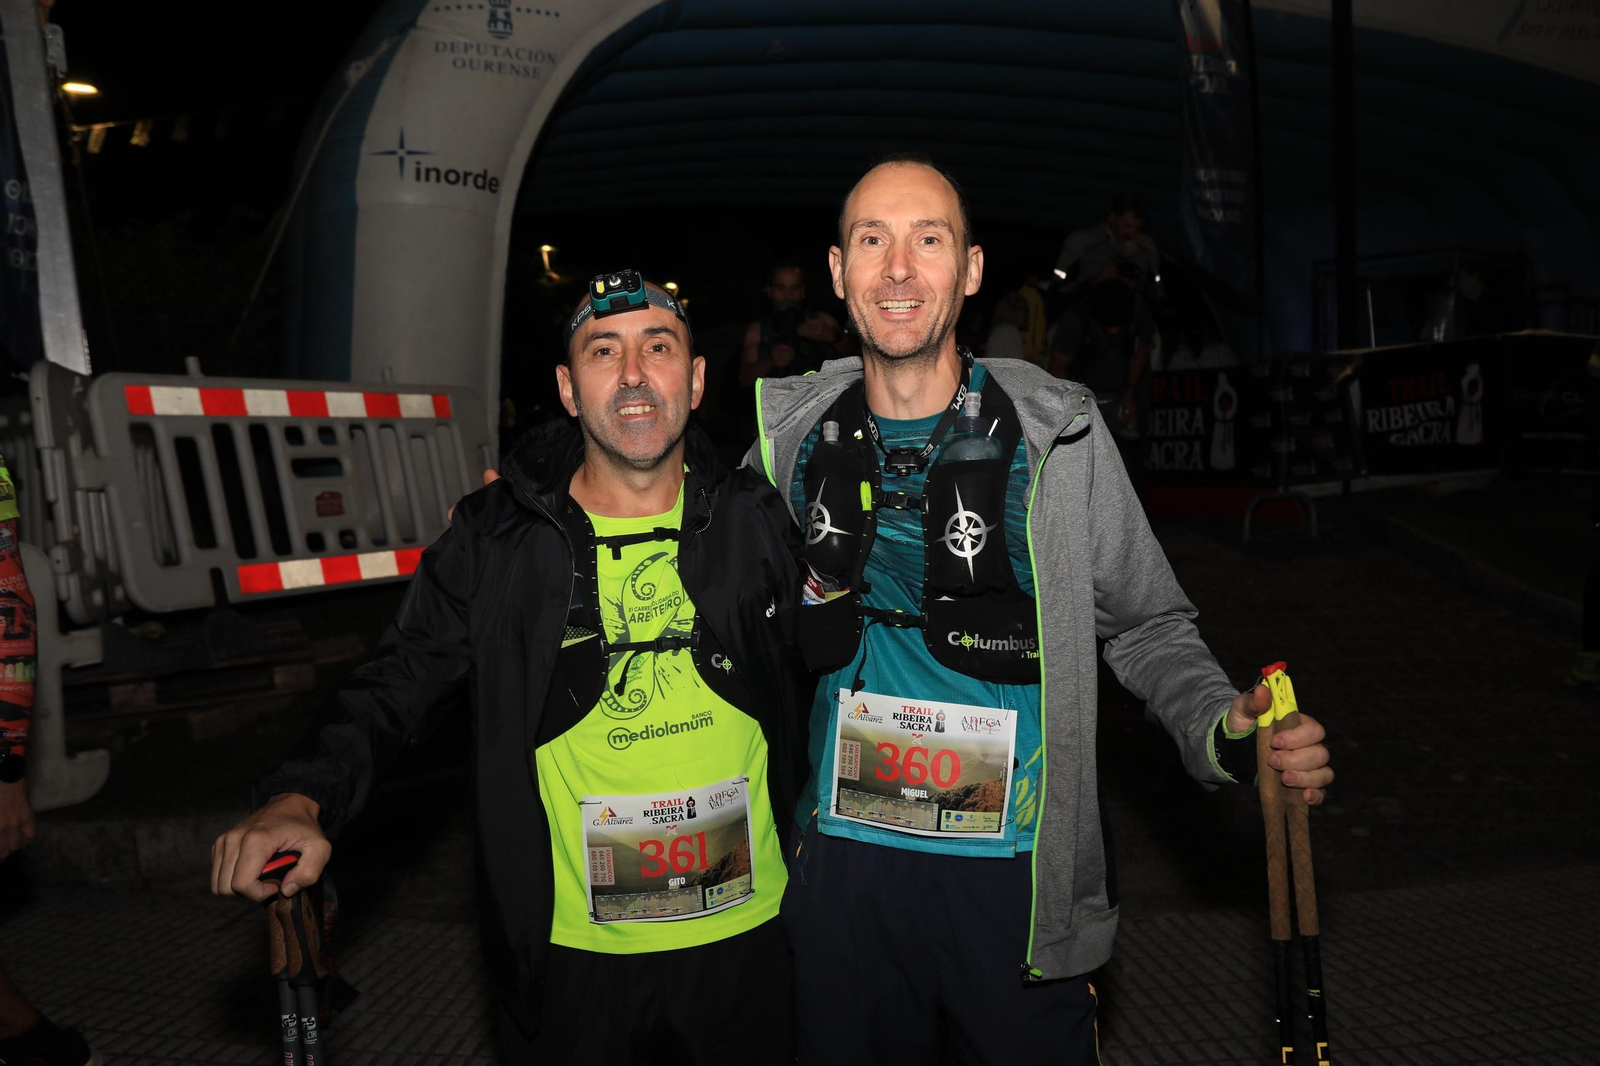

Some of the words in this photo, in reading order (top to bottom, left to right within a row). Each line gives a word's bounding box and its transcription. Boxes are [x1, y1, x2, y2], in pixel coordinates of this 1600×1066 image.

[435, 40, 557, 65] DEPUTACIÓN
[452, 57, 542, 80] OURENSE
[415, 162, 499, 193] inorde
[1388, 373, 1453, 404] TRAIL
[1366, 394, 1456, 434] RIBEIRA
[1390, 421, 1453, 447] SACRA
[1144, 440, 1206, 471] ACRA
[692, 710, 712, 720] BANCO
[892, 712, 932, 724] RIBEIRA
[902, 706, 934, 716] TRAIL
[609, 715, 714, 747] mediolanum
[900, 722, 932, 732] SACRA
[875, 742, 962, 788] 360
[900, 787, 928, 799] MIGUEL
[651, 798, 684, 808] TRAIL
[643, 807, 684, 818] RIBEIRA
[652, 814, 684, 825] SACRA
[639, 830, 710, 878] 361
[668, 876, 686, 886] GITO
[282, 1013, 296, 1027] GS
